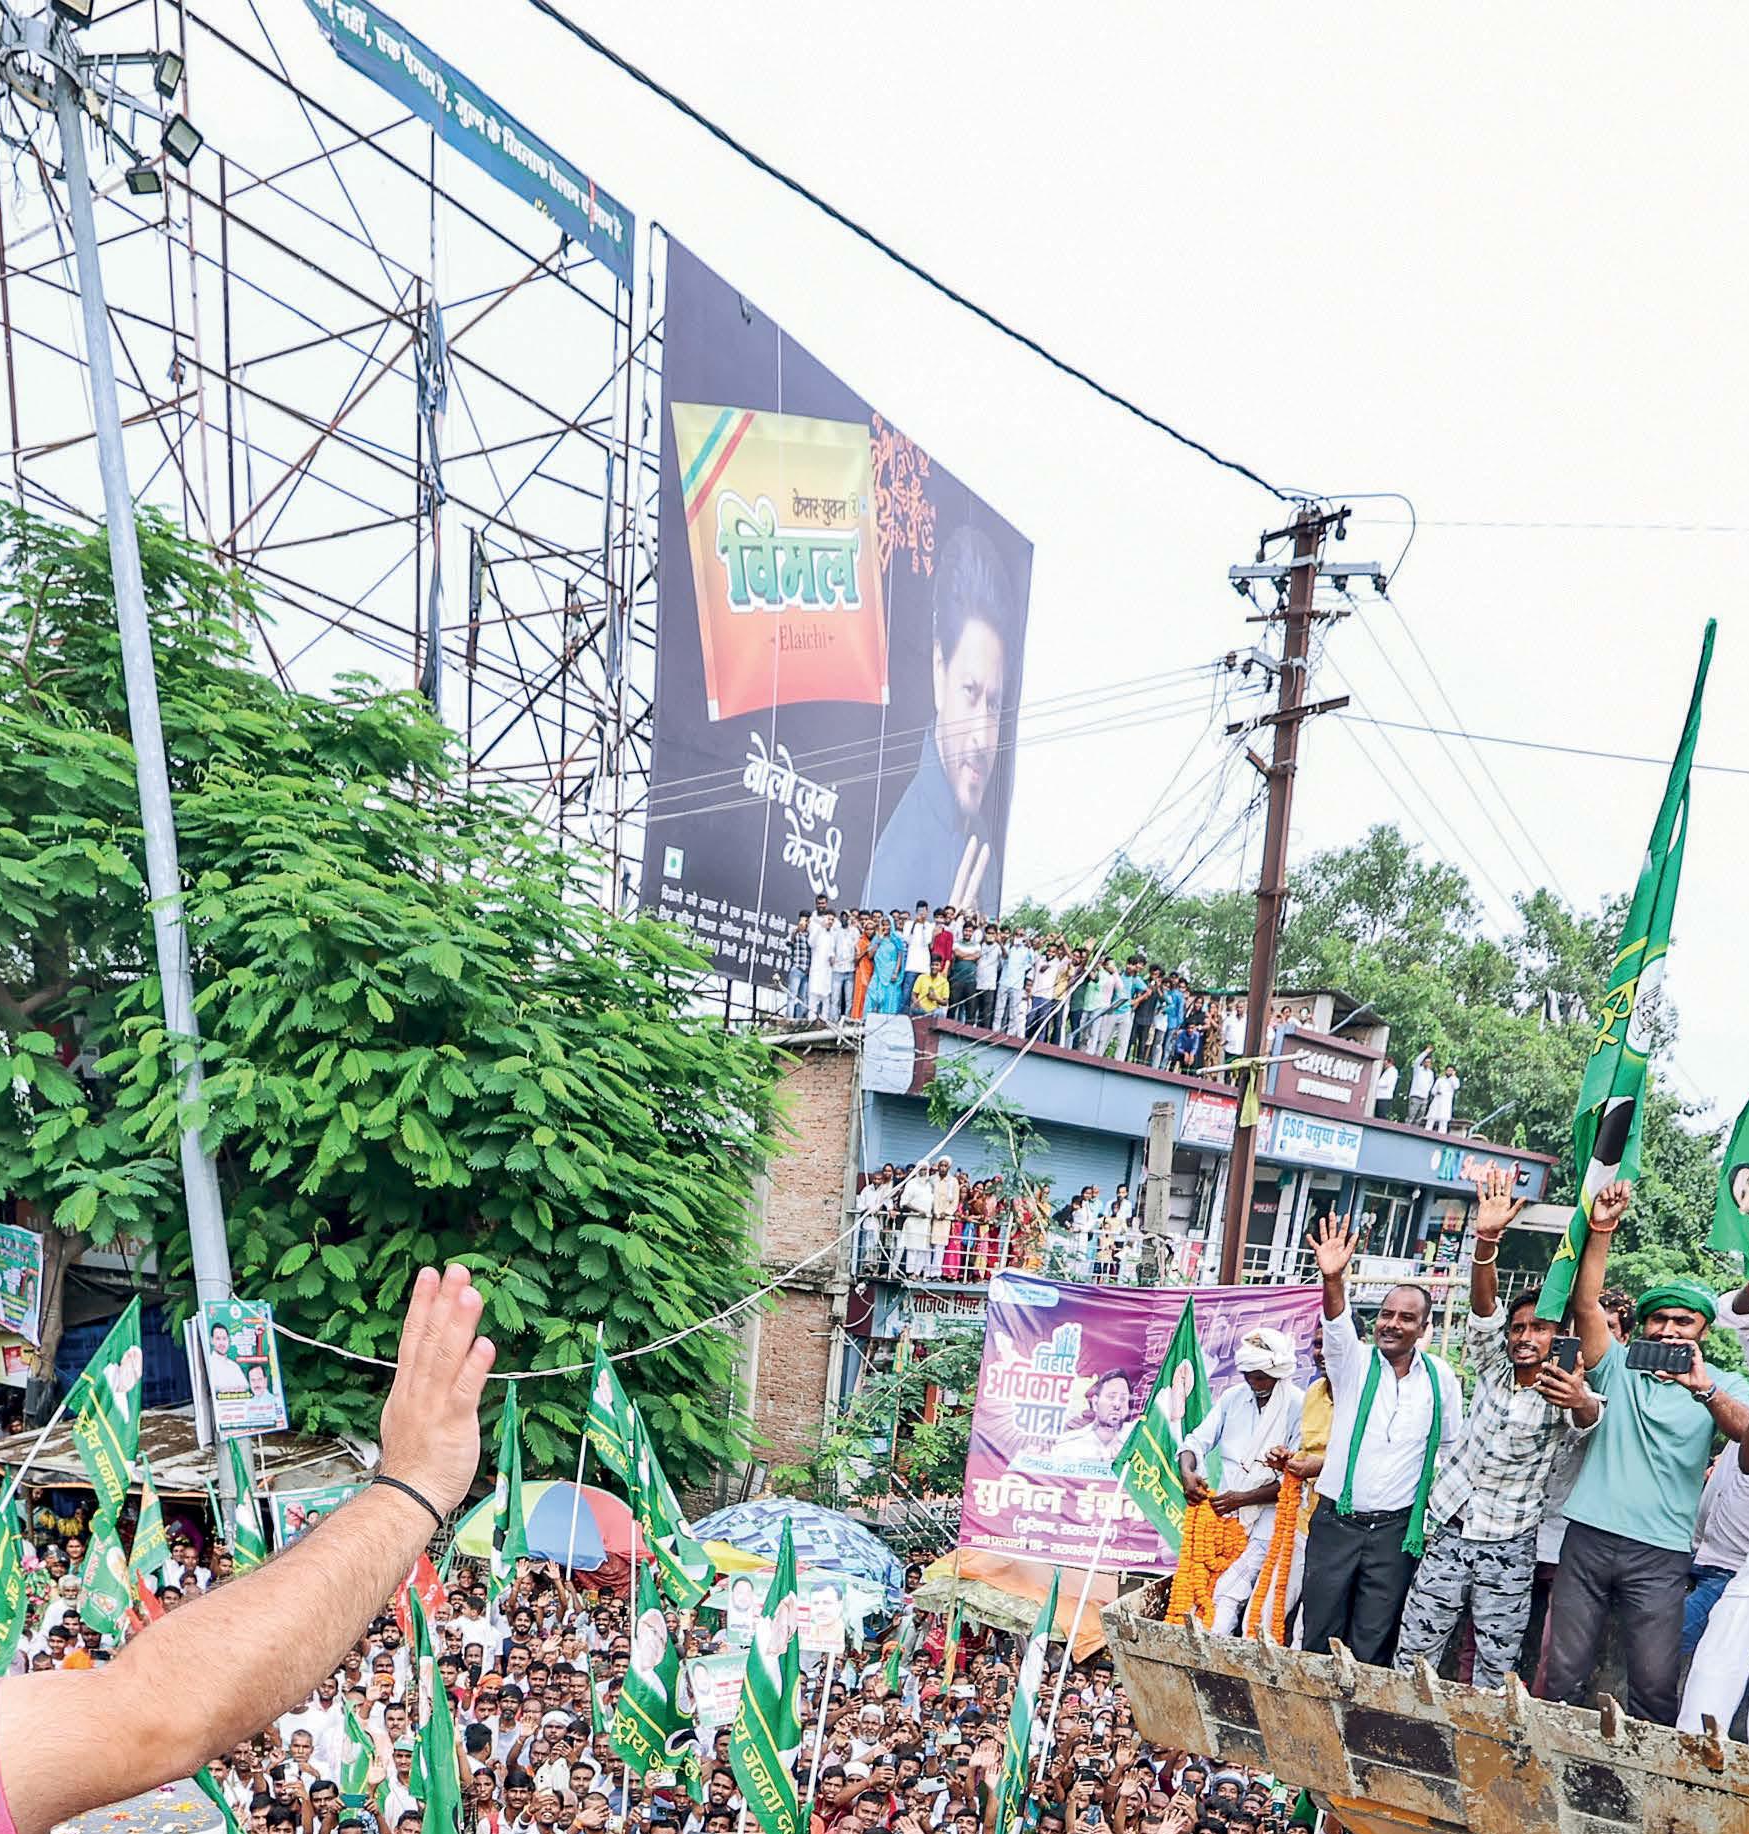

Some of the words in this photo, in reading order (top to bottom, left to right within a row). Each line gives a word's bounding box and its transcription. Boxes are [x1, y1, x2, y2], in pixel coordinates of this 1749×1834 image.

[718, 496, 861, 607] विमल
[779, 624, 828, 651] Elaichi
[743, 731, 798, 805] बोलो
[783, 807, 842, 900] केसरी
[1281, 1115, 1302, 1140] CSC
[1035, 1345, 1076, 1374] बिहार
[986, 1362, 1075, 1403] अधिकार
[1014, 1402, 1067, 1436] यात्रा
[972, 1473, 1067, 1517] सुनिल
[742, 1744, 784, 1815] जनता
